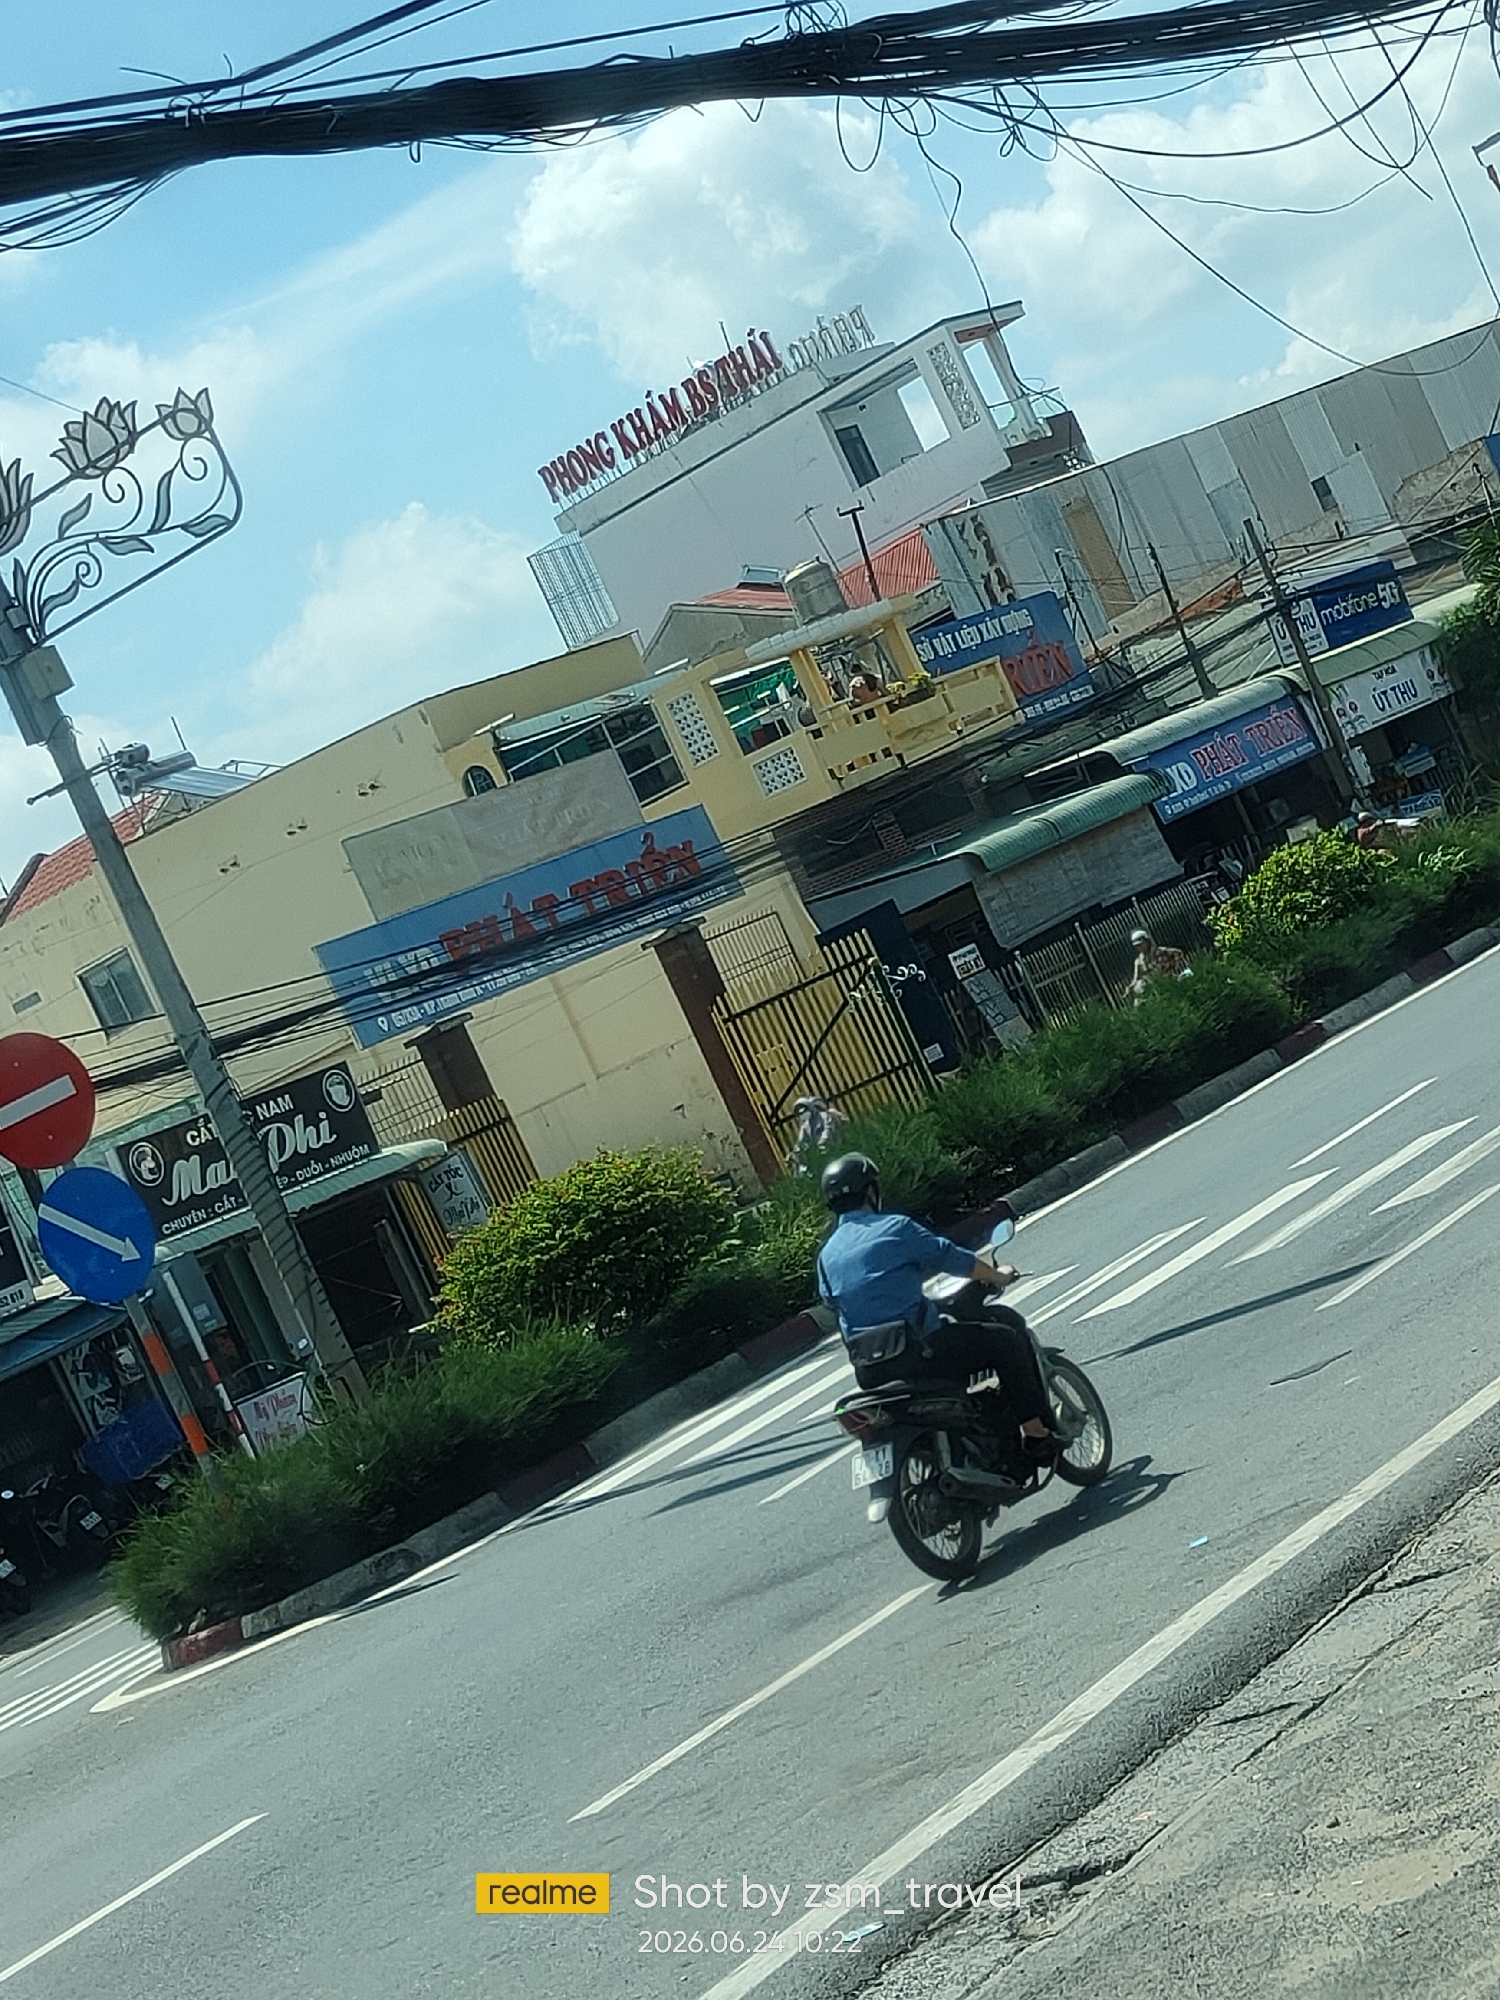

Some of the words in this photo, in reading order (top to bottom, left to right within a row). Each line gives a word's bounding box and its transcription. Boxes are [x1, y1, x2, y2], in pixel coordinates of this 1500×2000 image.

[610, 389, 689, 460] KHÁM
[713, 327, 782, 397] THÁI
[1320, 592, 1379, 626] mobifone
[1376, 580, 1401, 609] 5G
[932, 632, 958, 658] VẬT
[955, 624, 982, 650] LIỆU
[979, 616, 1004, 642] XÂY
[1002, 630, 1074, 699] RIỂN
[1372, 686, 1392, 712] ÚT
[1390, 678, 1418, 705] THU
[1189, 731, 1249, 781] PHÁT
[255, 1094, 294, 1120] NAM
[161, 1153, 238, 1206] Ma
[257, 1111, 338, 1174] Phi
